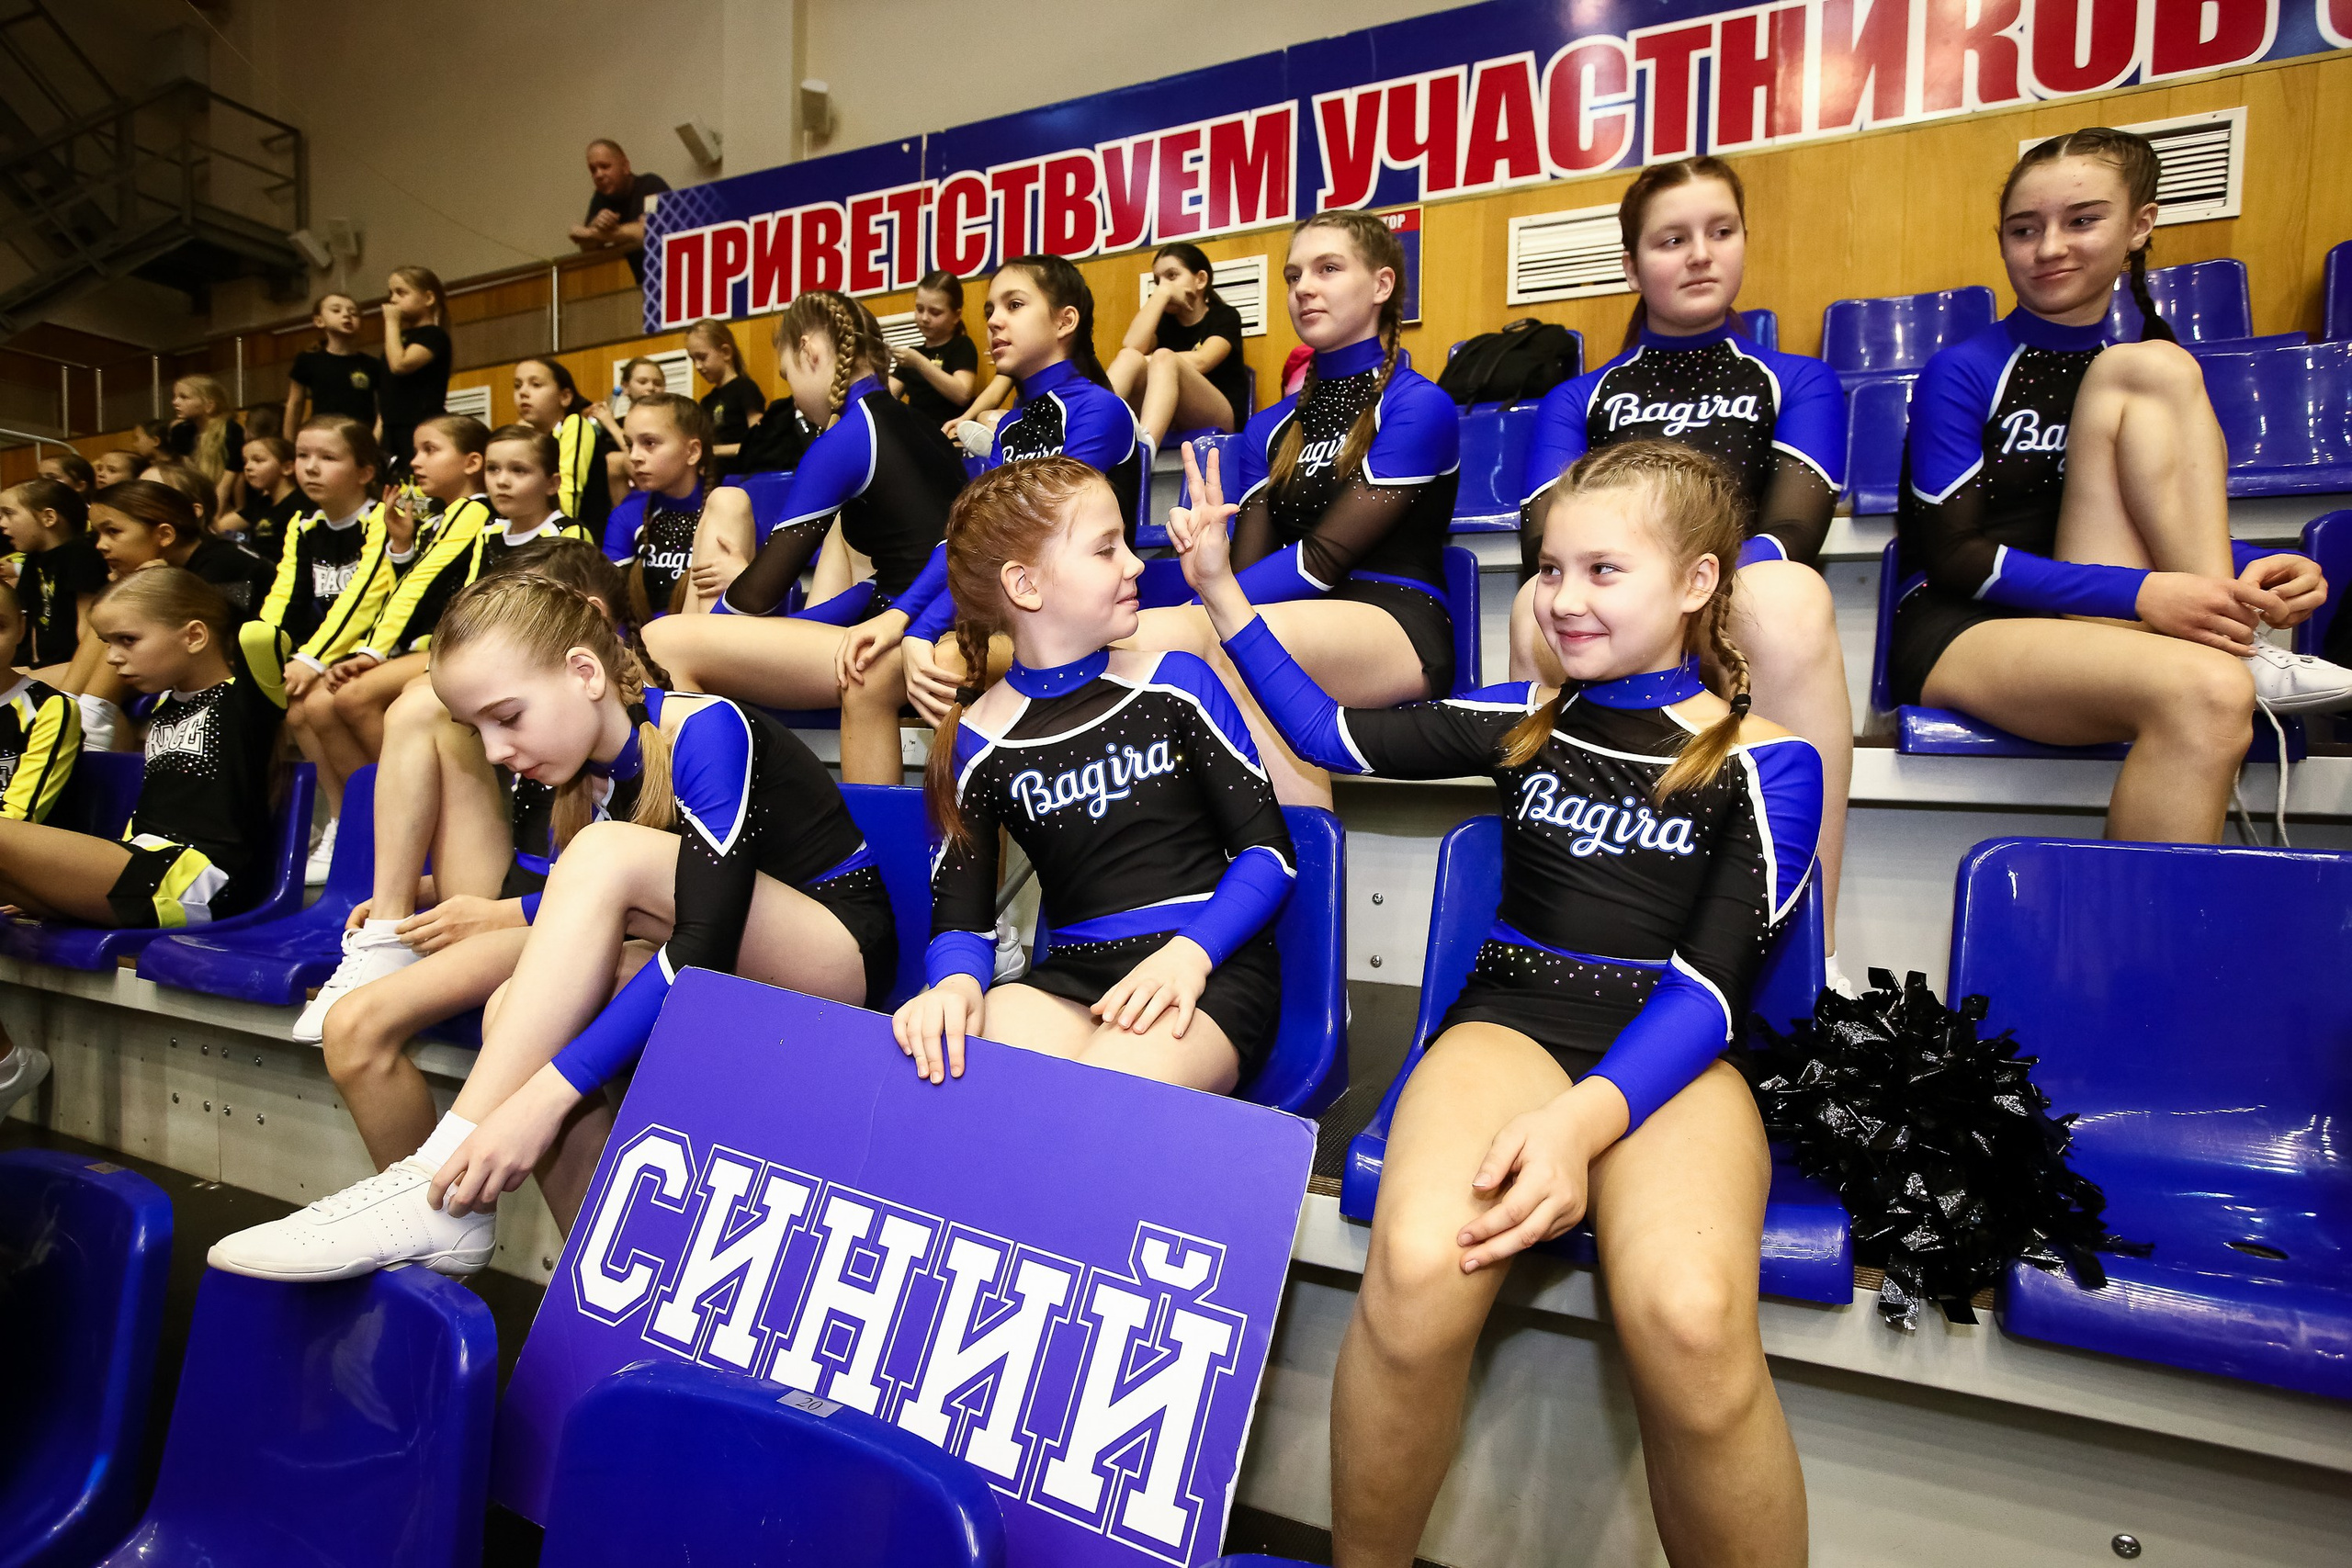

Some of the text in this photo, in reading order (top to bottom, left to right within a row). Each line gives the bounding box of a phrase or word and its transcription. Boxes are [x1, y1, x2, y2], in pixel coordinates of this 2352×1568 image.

[662, 99, 1298, 330] ПРИВЕТСТВУЕМ
[1603, 392, 1758, 436] Bagira
[638, 544, 693, 580] Bagi
[1011, 739, 1175, 819] Bagira
[1519, 772, 1696, 858] Bagira
[572, 1122, 1249, 1567] СИНИЙ
[796, 1397, 823, 1410] 20
